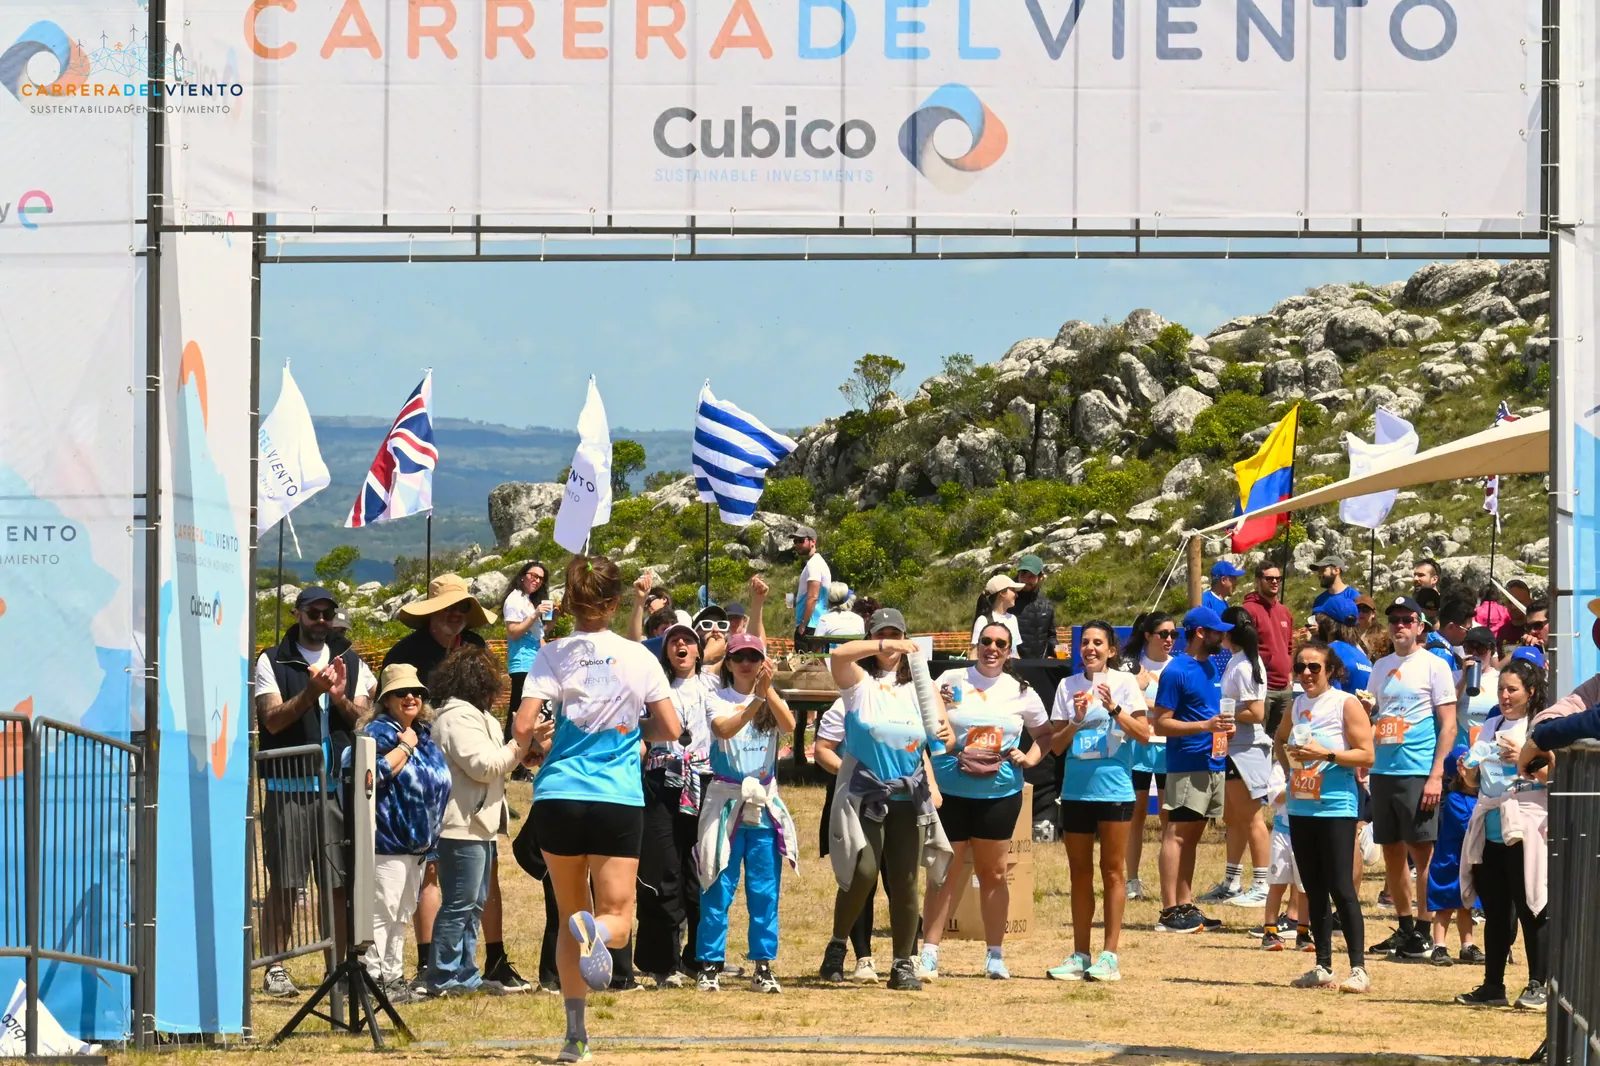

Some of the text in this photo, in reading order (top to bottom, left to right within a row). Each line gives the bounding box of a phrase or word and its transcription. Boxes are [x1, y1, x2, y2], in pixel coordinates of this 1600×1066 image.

[653, 106, 877, 159] Cubico
[655, 168, 875, 183] SUSTAINABLE INVESTMENTS
[6, 525, 77, 542] ENTO
[190, 595, 212, 619] Cubico
[579, 658, 604, 667] Cubico
[1380, 722, 1398, 736] 381
[1080, 735, 1100, 750] 157
[1294, 775, 1316, 790] 420
[2, 1013, 27, 1042] bico
